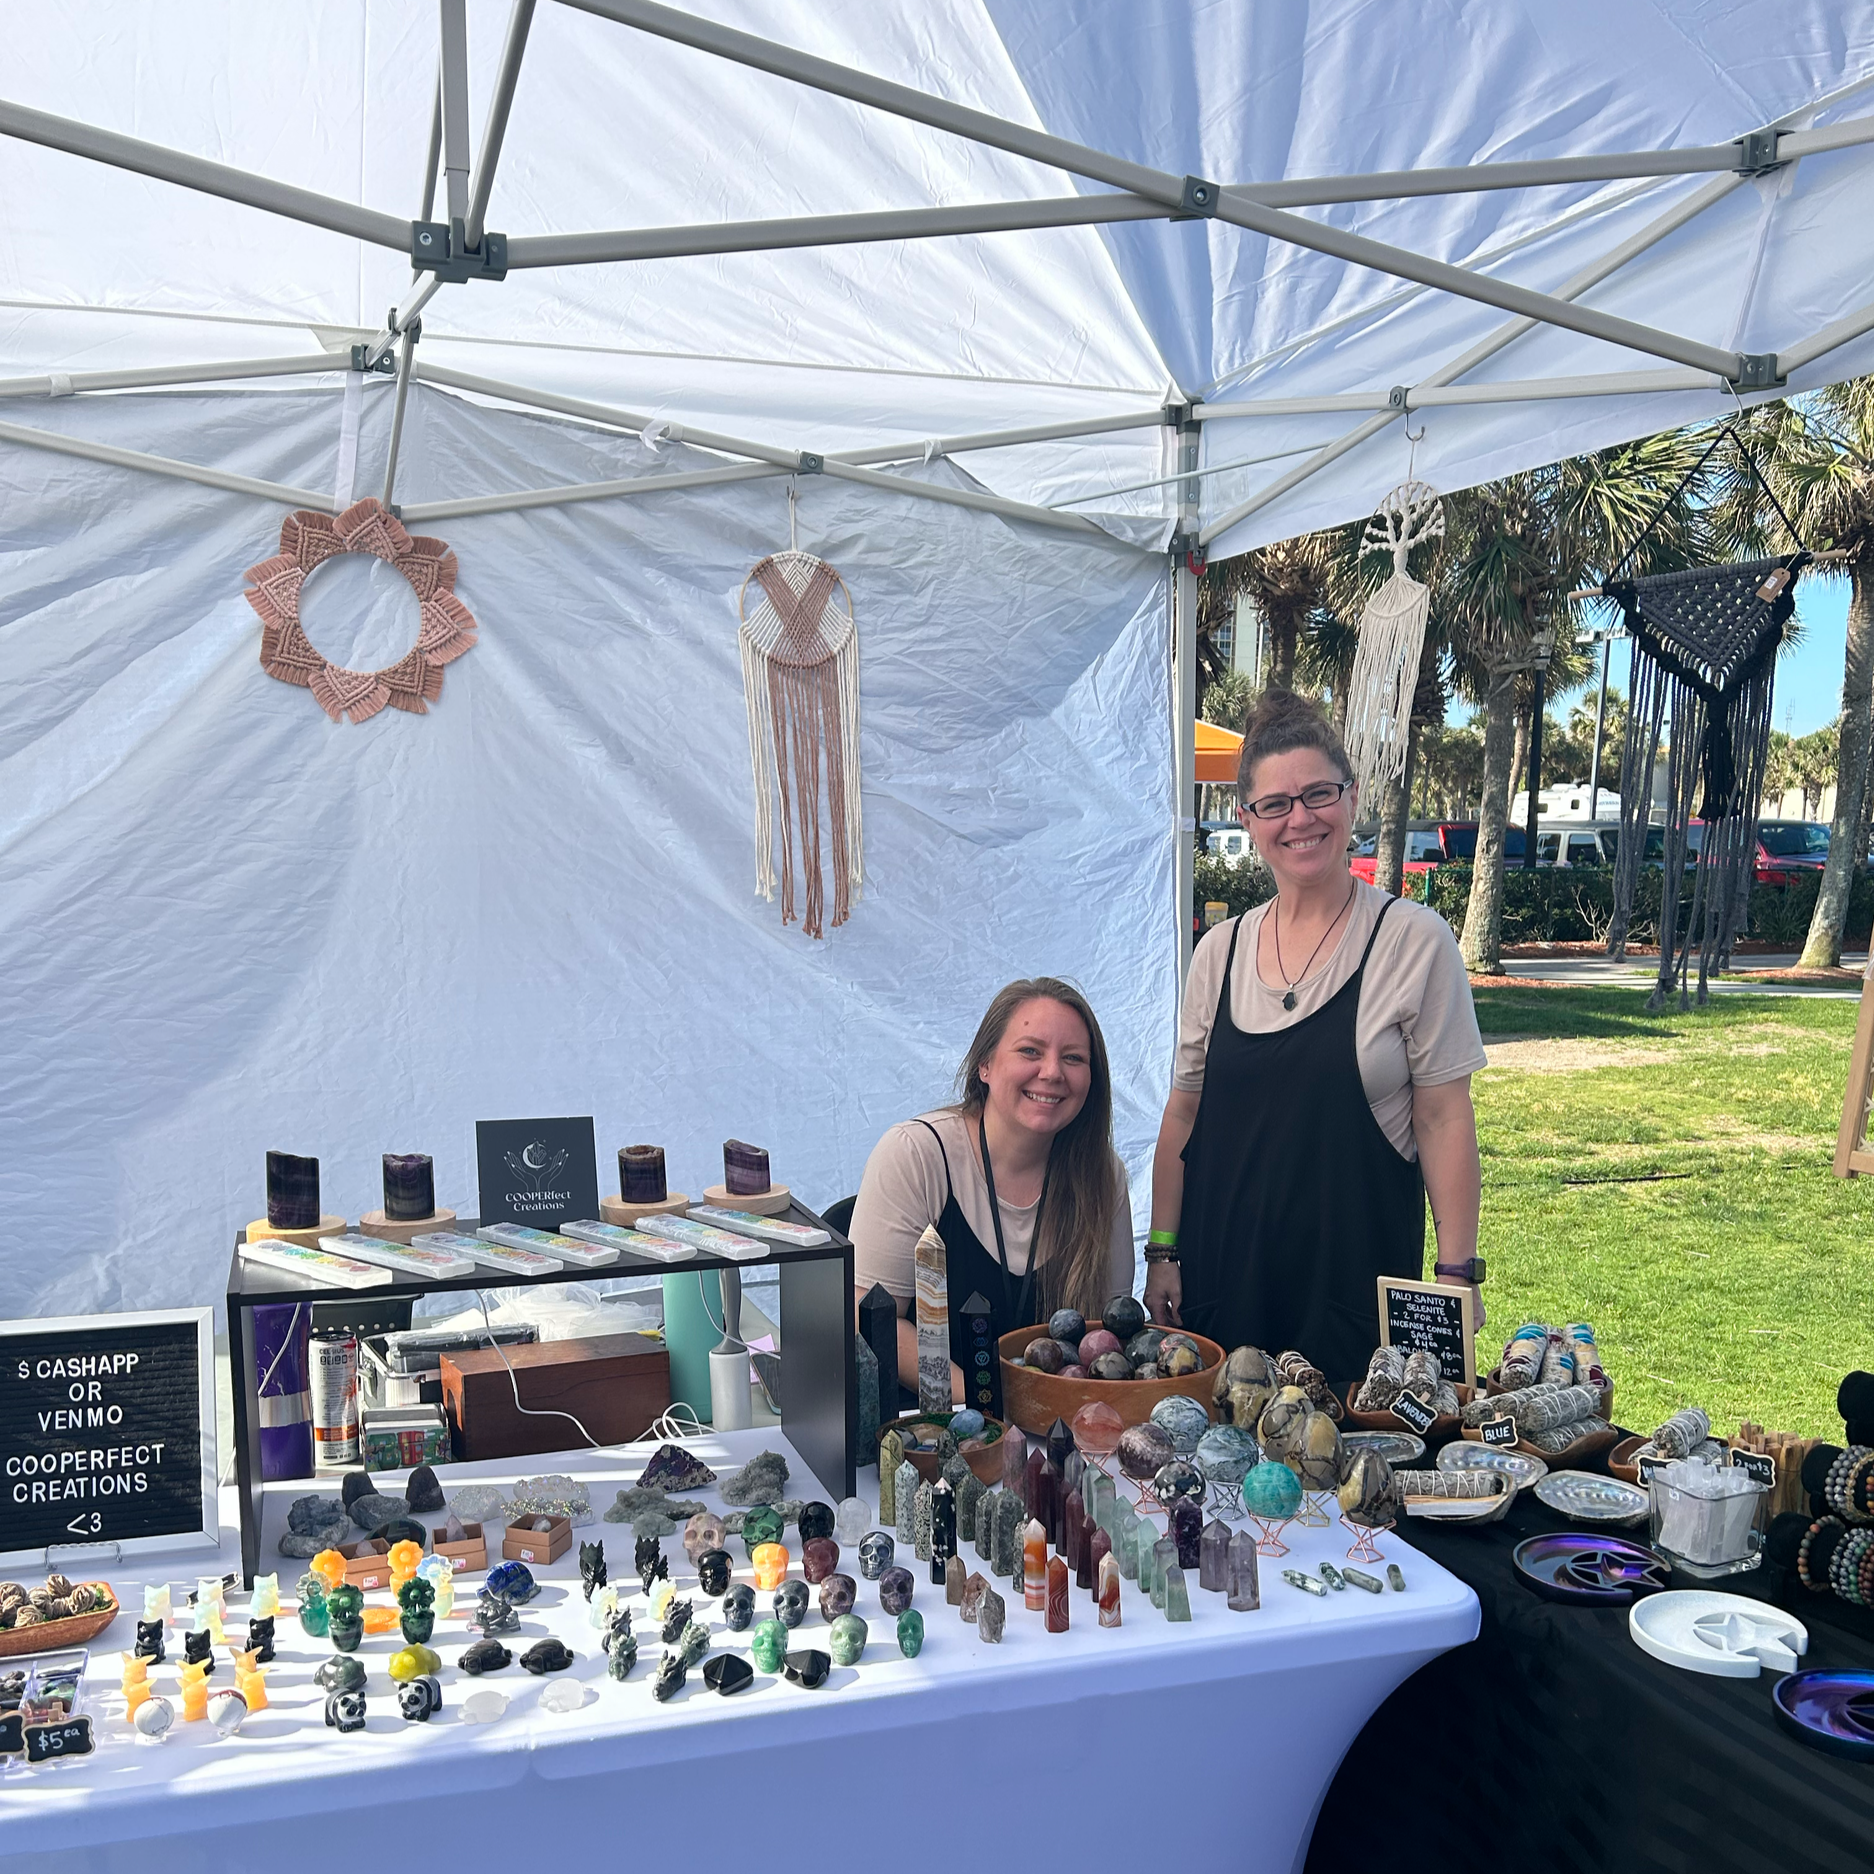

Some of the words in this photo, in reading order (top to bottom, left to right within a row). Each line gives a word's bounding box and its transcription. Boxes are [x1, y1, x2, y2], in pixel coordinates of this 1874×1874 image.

[505, 1190, 572, 1202] COOPERfect
[513, 1201, 565, 1212] Creations
[1391, 1290, 1411, 1300] PALO
[1414, 1294, 1446, 1307] SANTO
[1403, 1311, 1410, 1320] 2
[1414, 1313, 1433, 1323] FOR
[1437, 1316, 1449, 1325] $3
[1406, 1303, 1446, 1316] SELENITE
[1390, 1319, 1425, 1331] INCENSE
[1426, 1325, 1453, 1336] CONES
[1410, 1330, 1434, 1341] SAGE
[18, 1360, 30, 1379] $
[36, 1353, 139, 1379] CASHAPP
[68, 1381, 102, 1402] OR
[37, 1405, 123, 1432] VENMO
[1397, 1397, 1432, 1427] LAVENDER
[1485, 1426, 1510, 1441] BLUE
[6, 1443, 165, 1477] COOPERFECT
[13, 1472, 148, 1503] CREATIONS
[66, 1511, 102, 1535] <3
